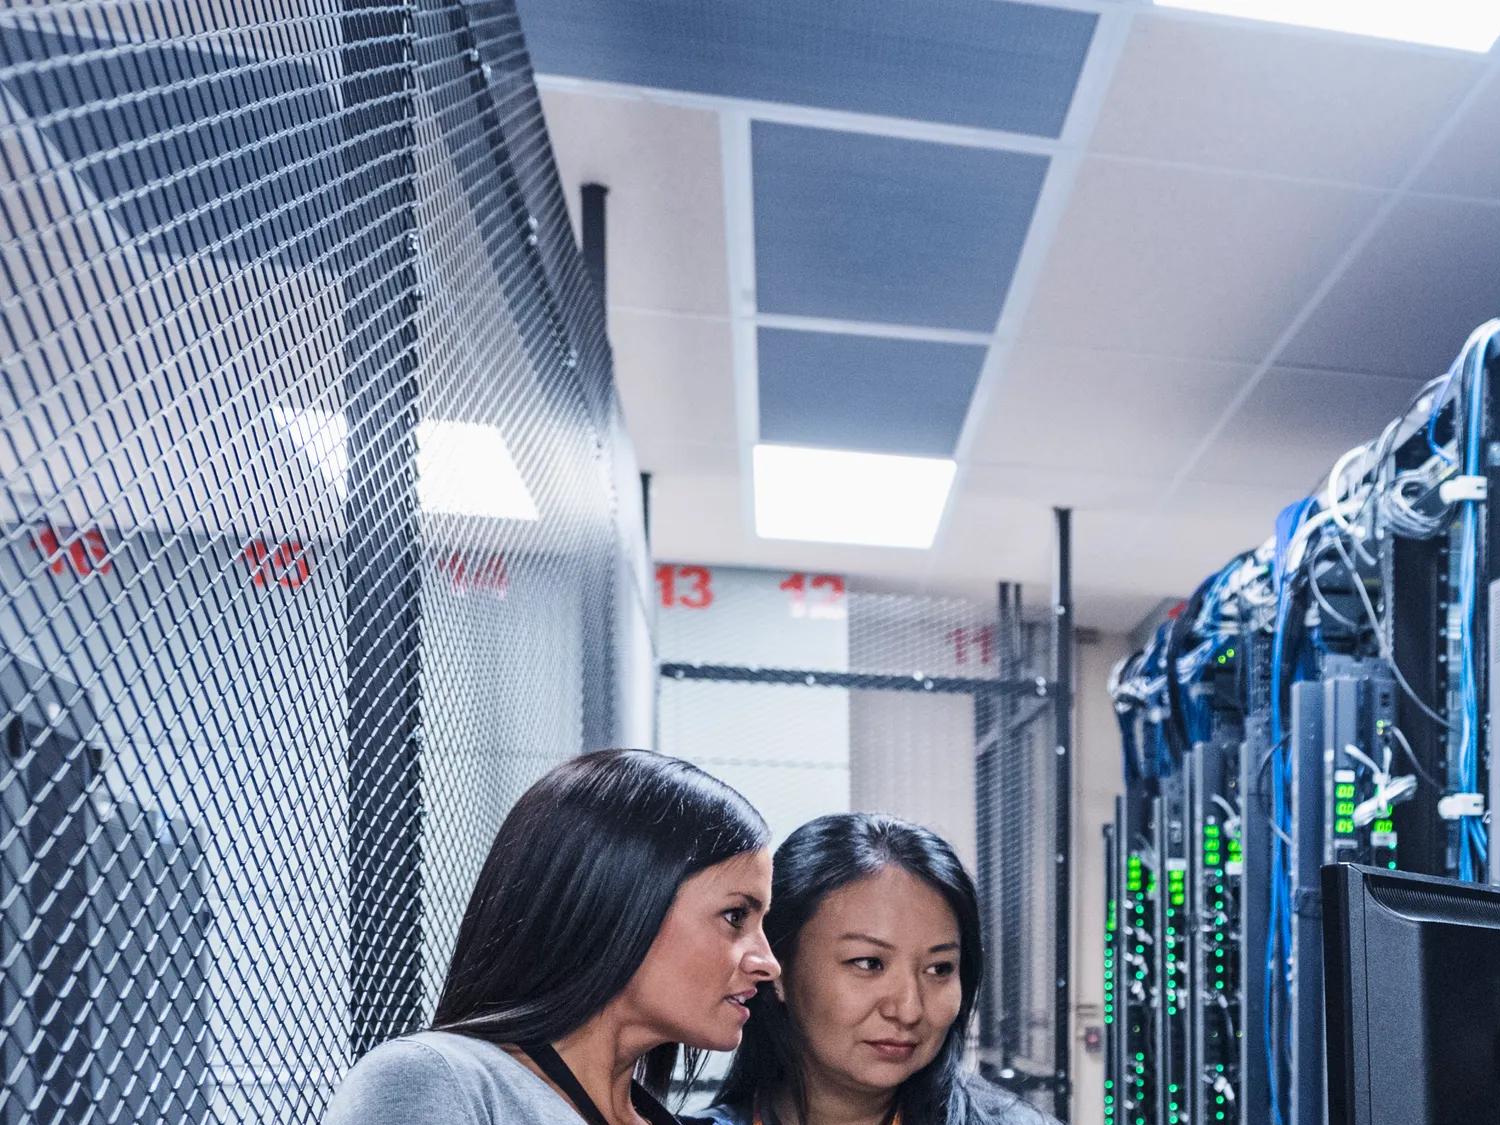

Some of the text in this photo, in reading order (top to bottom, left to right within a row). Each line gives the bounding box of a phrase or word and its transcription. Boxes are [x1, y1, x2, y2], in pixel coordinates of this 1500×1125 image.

[655, 564, 714, 609] 13
[780, 571, 846, 619] 12
[946, 625, 995, 665] 11
